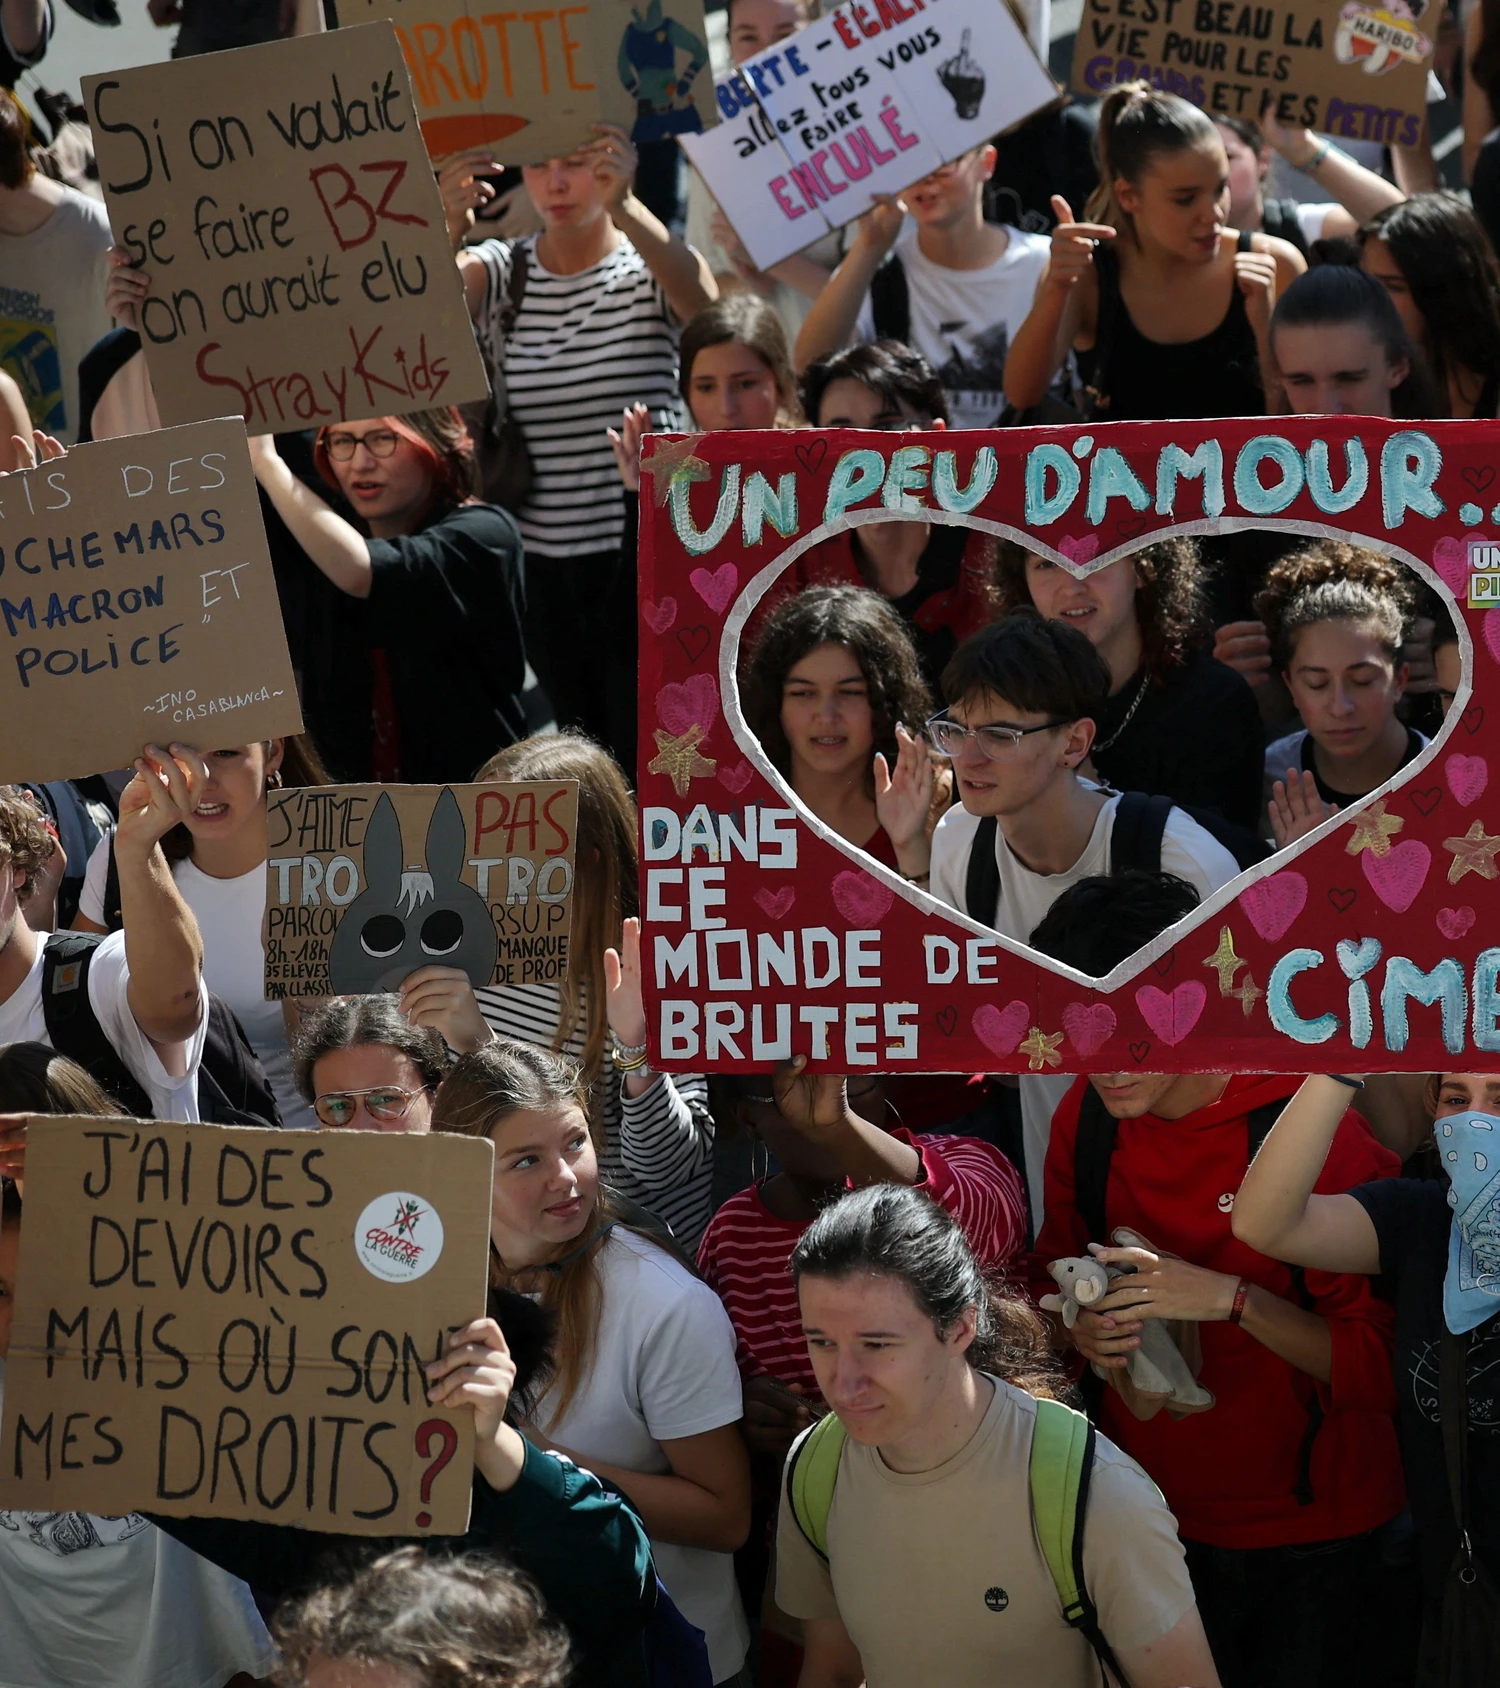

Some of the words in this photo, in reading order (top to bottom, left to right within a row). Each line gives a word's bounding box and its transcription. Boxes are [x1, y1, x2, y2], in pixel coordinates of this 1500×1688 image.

[1162, 31, 1228, 71] POUR
[1235, 46, 1292, 82] LES
[1195, 0, 1274, 40] BEAU
[1283, 14, 1323, 48] LA
[1354, 15, 1417, 51] HARIBO
[715, 44, 810, 122] BERTE
[833, 0, 926, 50] ÉGAL
[94, 82, 171, 194] Si
[190, 116, 254, 171] on
[267, 71, 406, 151] voulait
[733, 107, 808, 158] allez
[811, 67, 870, 108] tous
[1211, 81, 1253, 112] ET
[1325, 97, 1423, 147] PETITS
[768, 95, 920, 221] ENCULÉ
[124, 219, 175, 268] se
[194, 196, 294, 260] faire
[309, 160, 428, 251] BZ
[141, 288, 207, 344] on
[223, 255, 340, 324] aurait
[361, 241, 427, 303] elu
[0, 471, 71, 519] IS
[121, 453, 226, 498] DES
[668, 463, 800, 556] UN
[823, 445, 998, 527] PEU
[0, 509, 225, 576] CHEMARS
[1, 575, 165, 637] MACRON
[199, 562, 250, 608] ET
[268, 789, 368, 854] J'AIME
[474, 789, 570, 856] PAS
[643, 804, 798, 870] DANS
[269, 855, 359, 907] TRO
[467, 856, 573, 906] TRO
[647, 867, 727, 931] CE
[266, 965, 281, 978] 35
[495, 963, 514, 985] DE
[523, 957, 568, 984] PROF
[498, 936, 569, 959] MANQUE
[653, 926, 882, 992] MONDE
[923, 935, 999, 985] DE
[266, 982, 288, 1000] PAR
[289, 979, 331, 997] CLASSE
[660, 1000, 919, 1065] BRUTES
[217, 1145, 334, 1210] DES
[88, 1215, 328, 1300] DEVOIRS
[365, 1239, 377, 1251] LA
[380, 1245, 418, 1269] GUERRE
[366, 1228, 424, 1258] CONTRE
[45, 1305, 190, 1391] MAIS
[218, 1306, 296, 1395] OÙ
[326, 1324, 465, 1407] SON
[14, 1412, 124, 1482] MES
